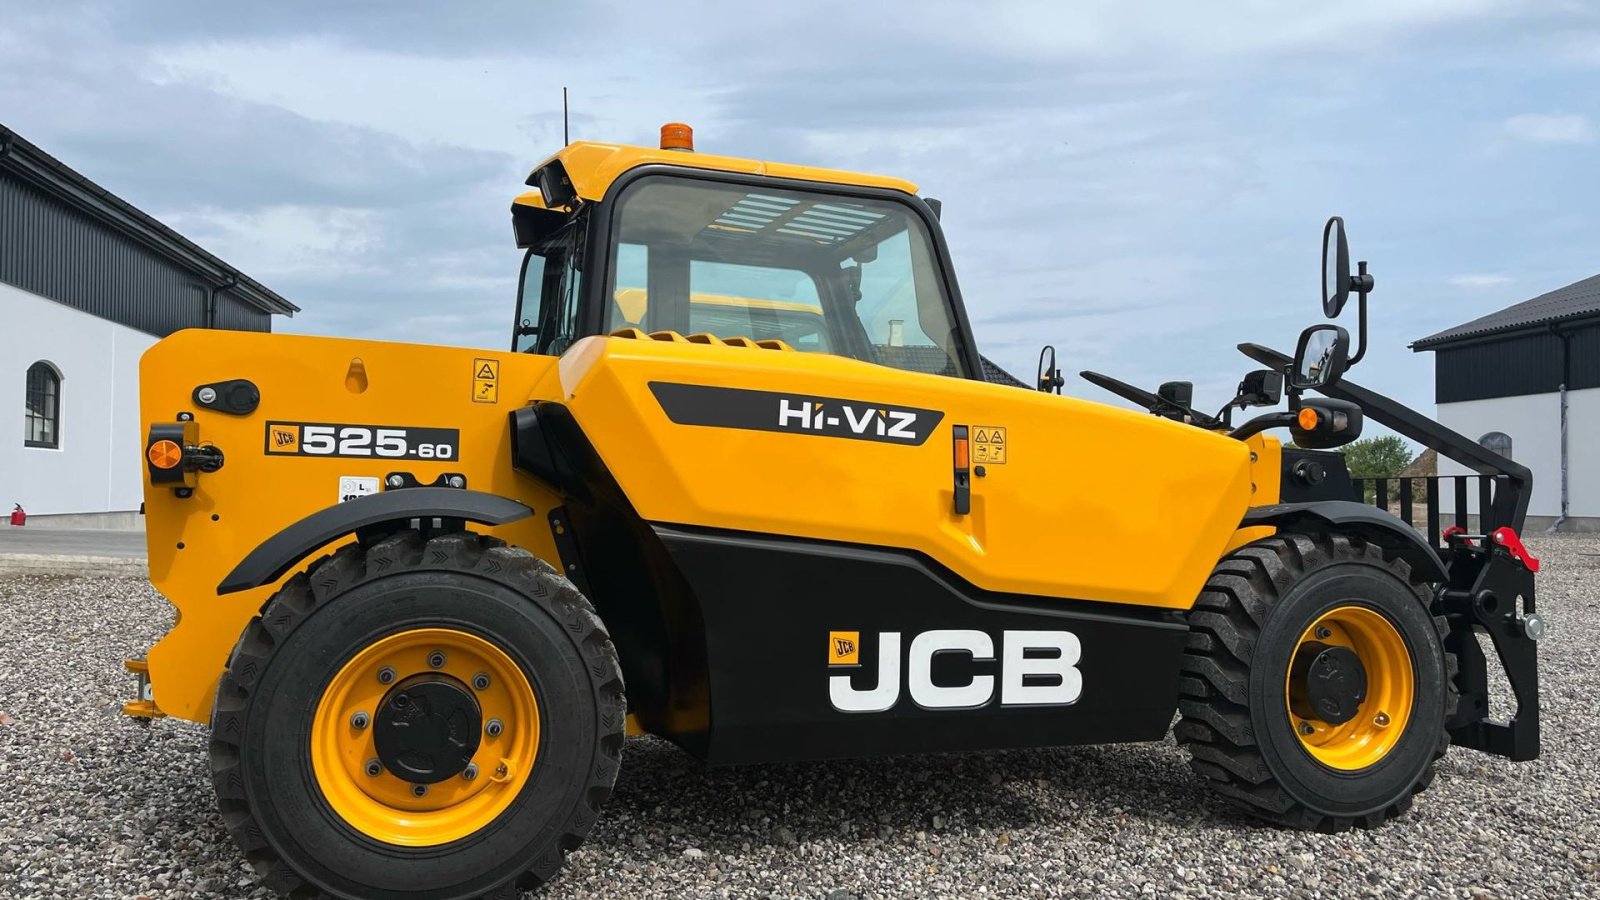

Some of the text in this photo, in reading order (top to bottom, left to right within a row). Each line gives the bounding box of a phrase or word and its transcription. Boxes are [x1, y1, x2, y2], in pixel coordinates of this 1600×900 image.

[277, 426, 452, 458] JCB 525-60
[837, 640, 854, 655] JCB
[829, 629, 1083, 711] JCB
